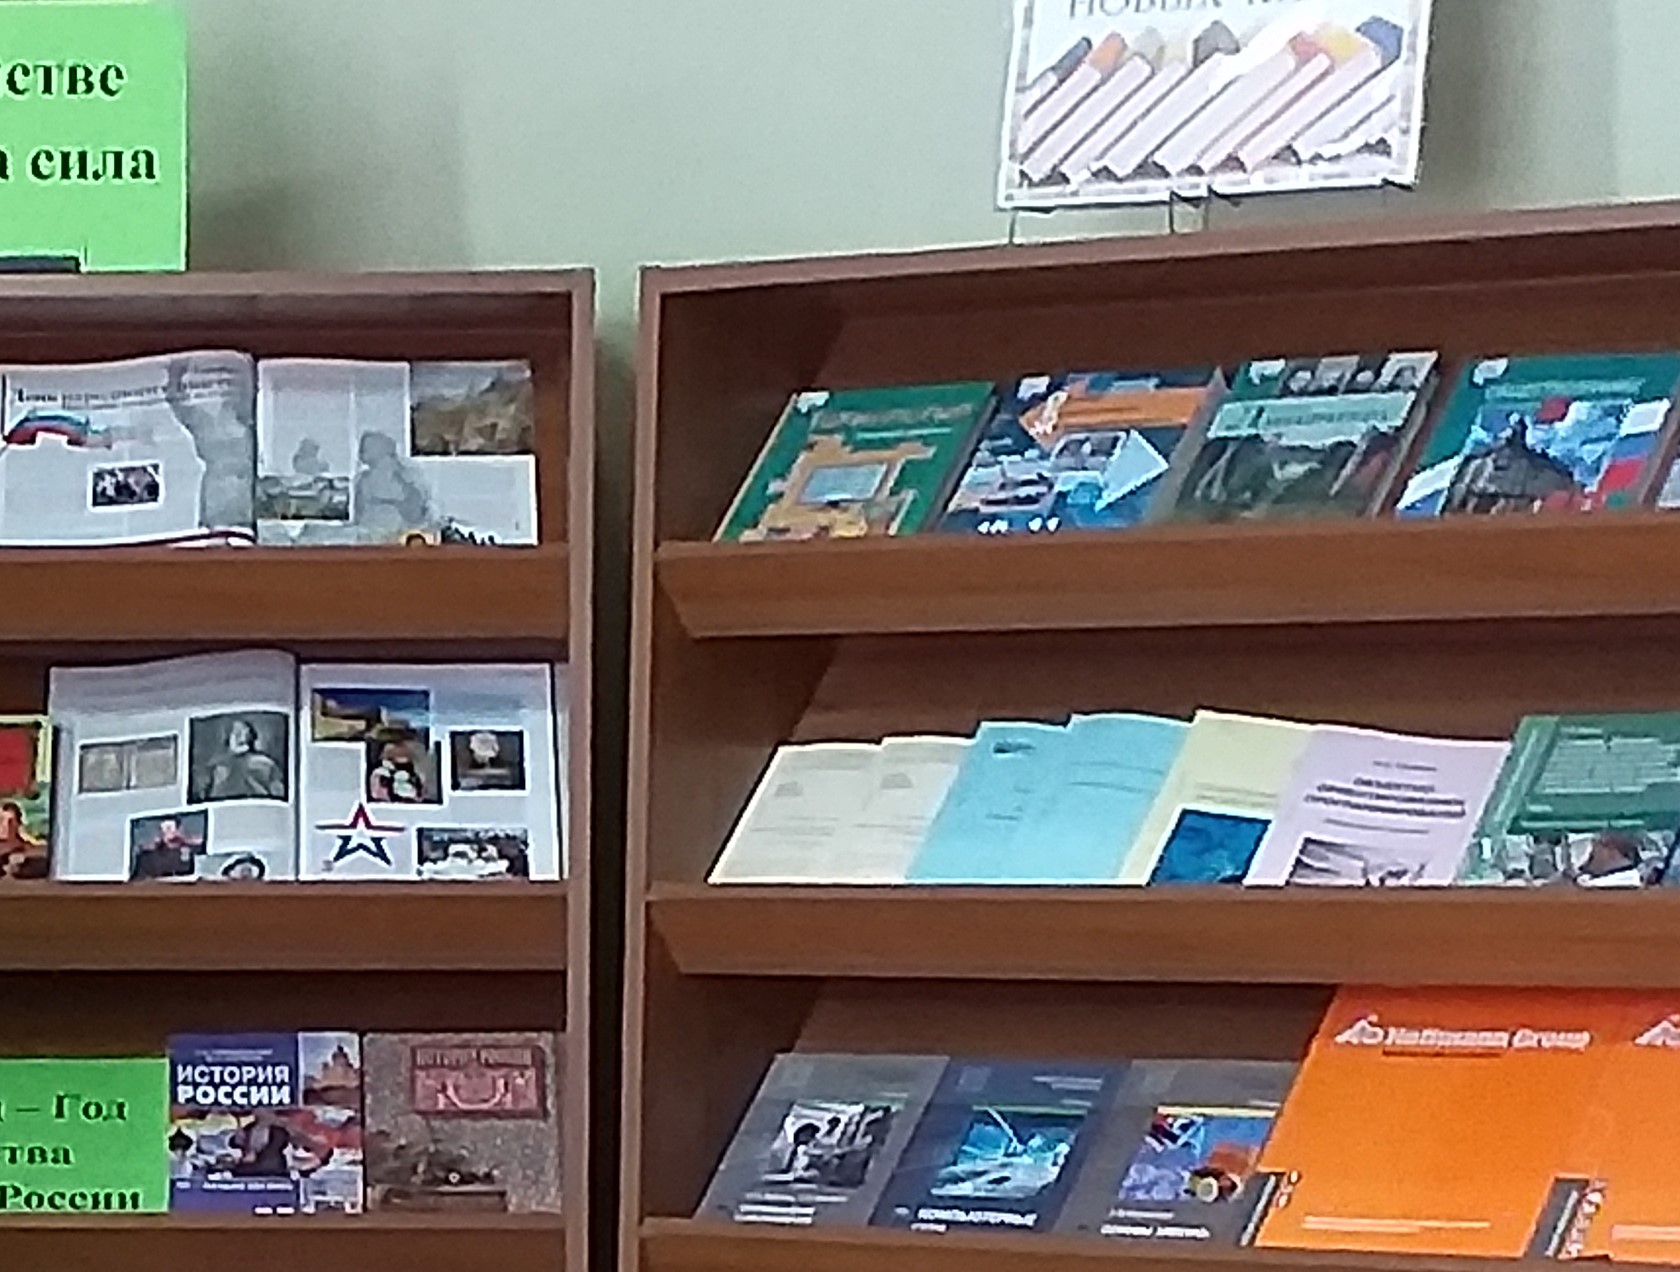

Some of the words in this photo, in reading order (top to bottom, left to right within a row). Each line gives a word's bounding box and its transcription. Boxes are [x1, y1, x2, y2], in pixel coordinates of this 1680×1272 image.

[29, 146, 158, 182] сила
[176, 1064, 289, 1084] ИСТОРИЯ
[177, 1085, 291, 1105] РОССИИ
[54, 1094, 128, 1122] Год
